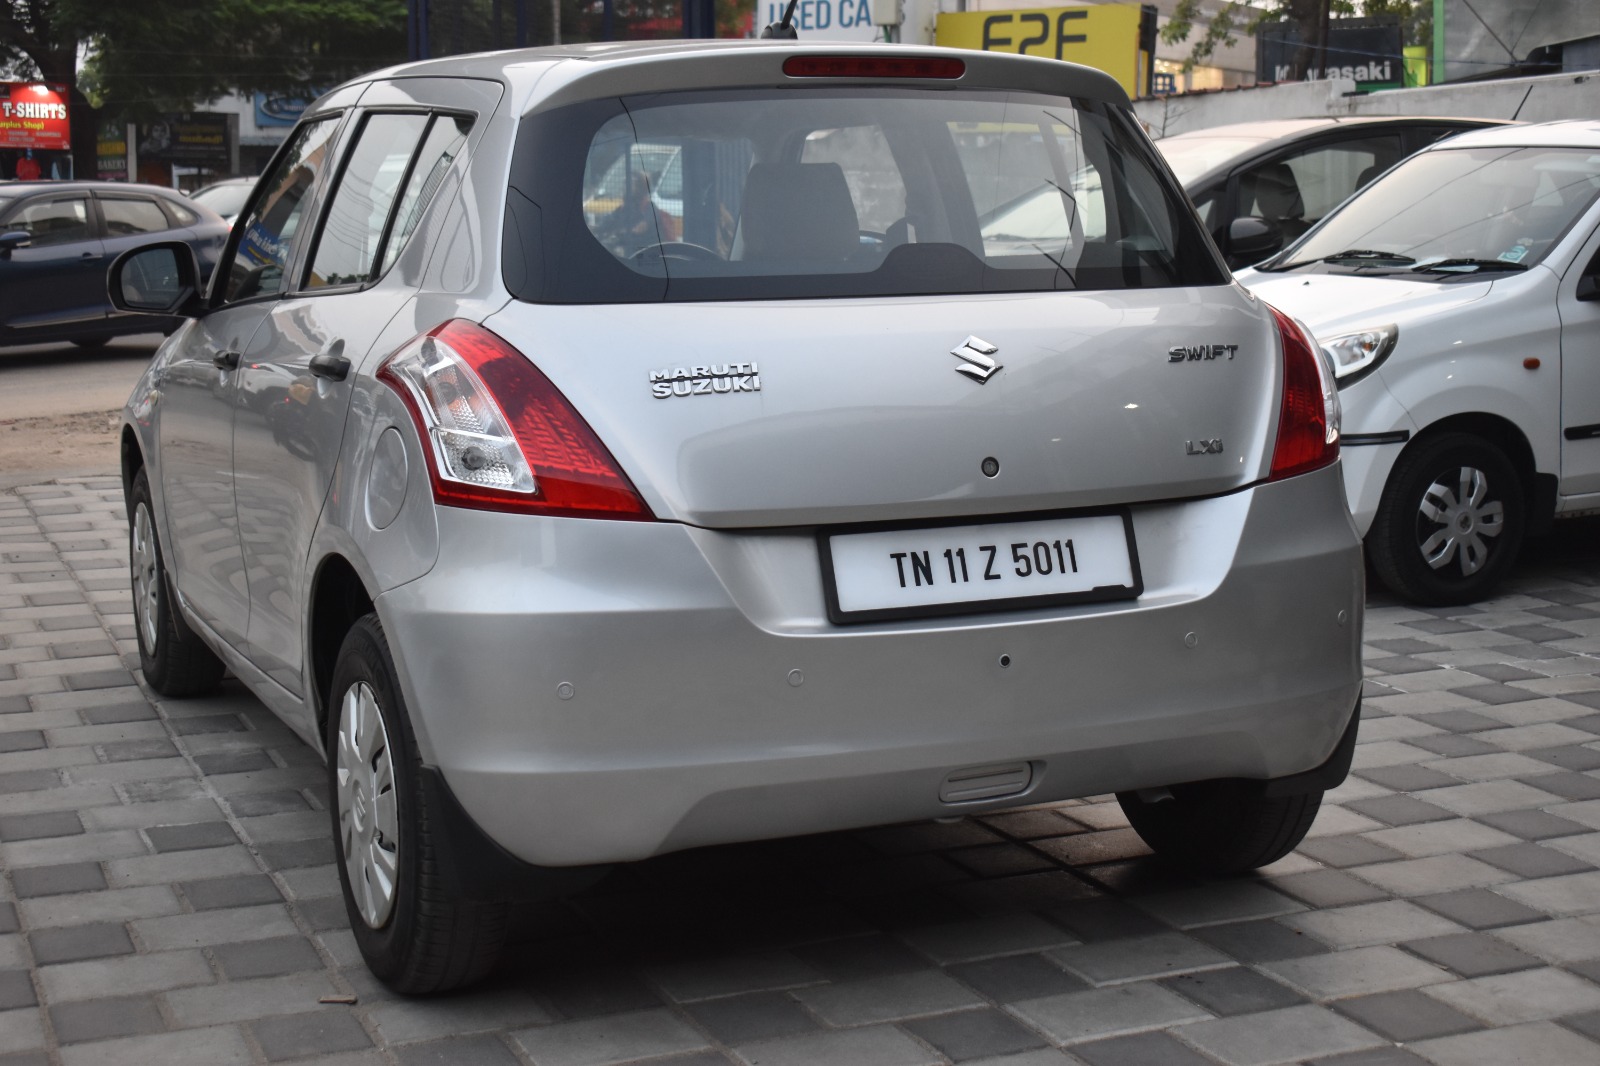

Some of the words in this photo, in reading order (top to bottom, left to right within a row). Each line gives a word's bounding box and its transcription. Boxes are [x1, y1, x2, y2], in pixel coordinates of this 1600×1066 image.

[839, 0, 872, 28] CA
[1274, 60, 1391, 82] Kwasaki
[3, 102, 66, 119] T-SHIRTS
[1168, 344, 1238, 363] SWIFT
[649, 362, 758, 382] MARUTI
[652, 375, 761, 399] SUZUKI
[889, 550, 934, 588] TN
[943, 547, 969, 584] 11
[979, 545, 1002, 581] Z
[1010, 538, 1079, 578] 5011
